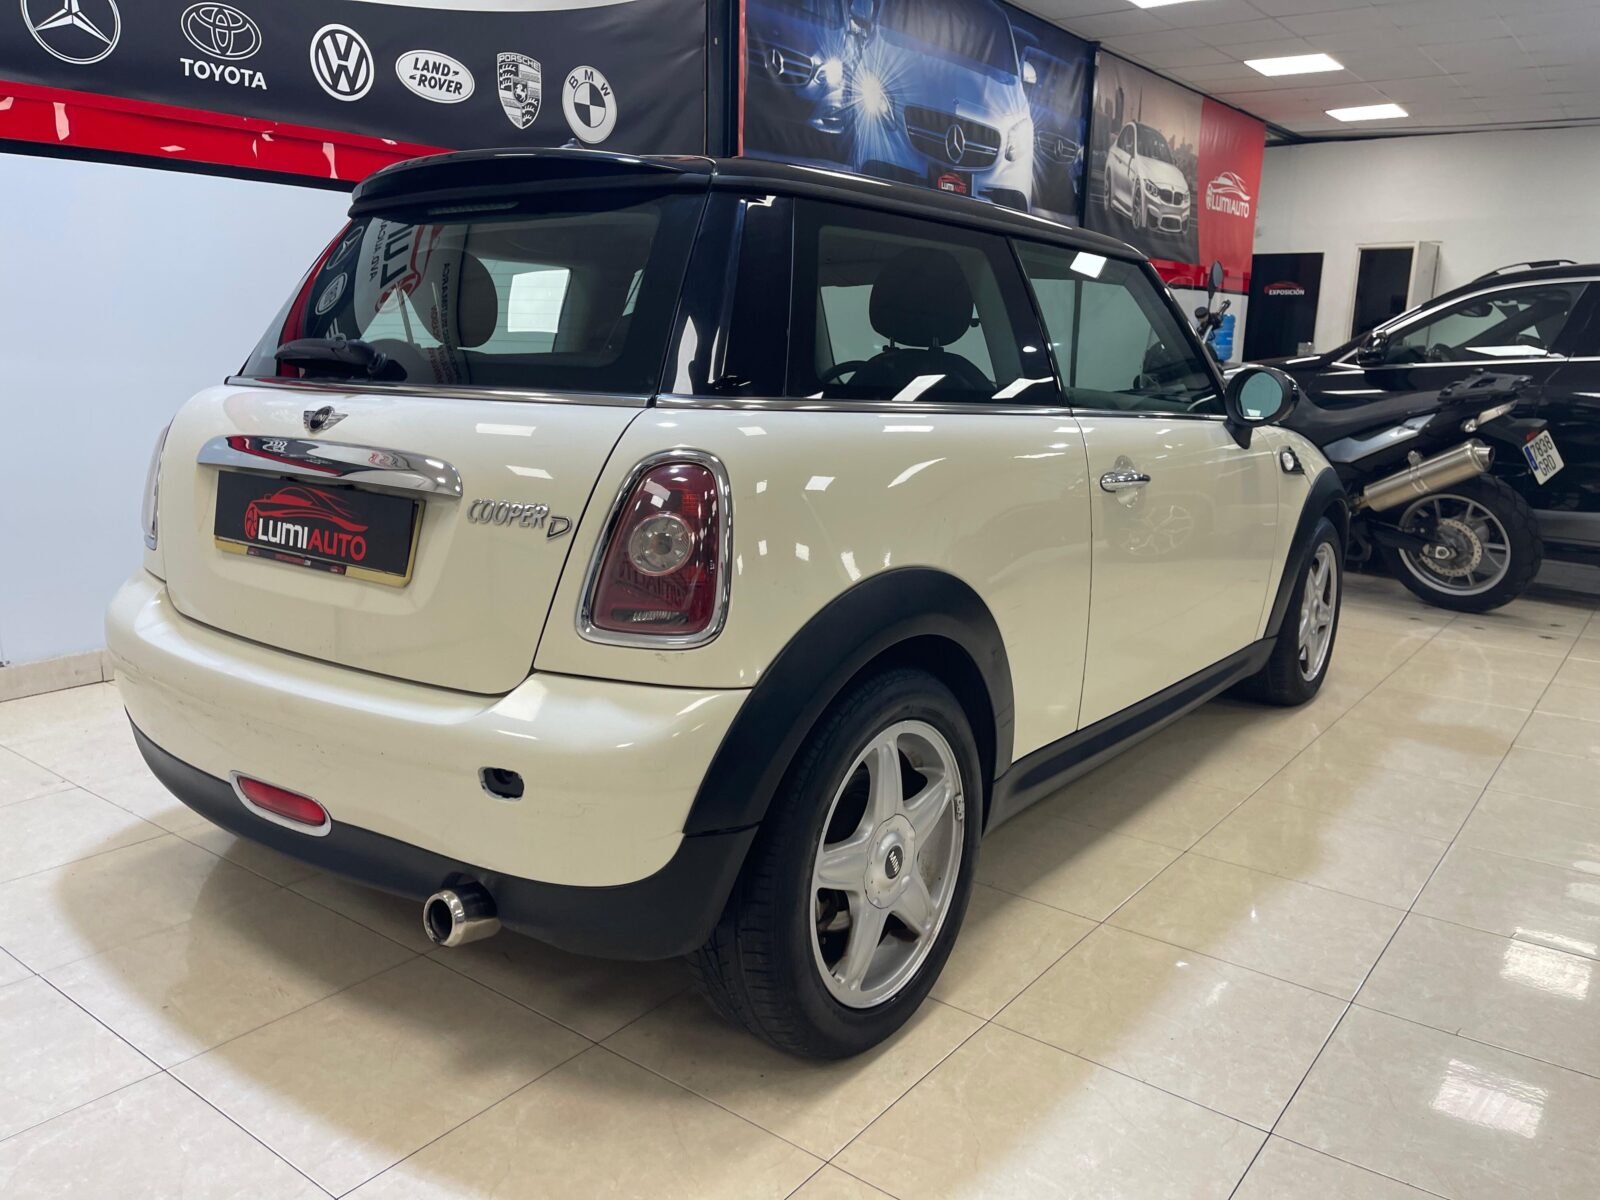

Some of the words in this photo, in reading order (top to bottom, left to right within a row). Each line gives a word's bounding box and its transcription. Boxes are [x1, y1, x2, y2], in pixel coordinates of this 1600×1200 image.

[180, 57, 267, 90] TOYOTA
[413, 57, 451, 77] LAND
[498, 53, 540, 72] PORSCHE
[417, 74, 463, 95] ROVER
[568, 69, 611, 97] BMW
[1211, 194, 1250, 218] LUMIAUTO
[1268, 287, 1305, 296] EXPOSICIÓN
[1530, 435, 1553, 461] 7838
[467, 499, 550, 529] COOPER
[546, 515, 573, 541] D
[257, 518, 367, 561] LUMIAUTO
[888, 850, 900, 875] MINI
